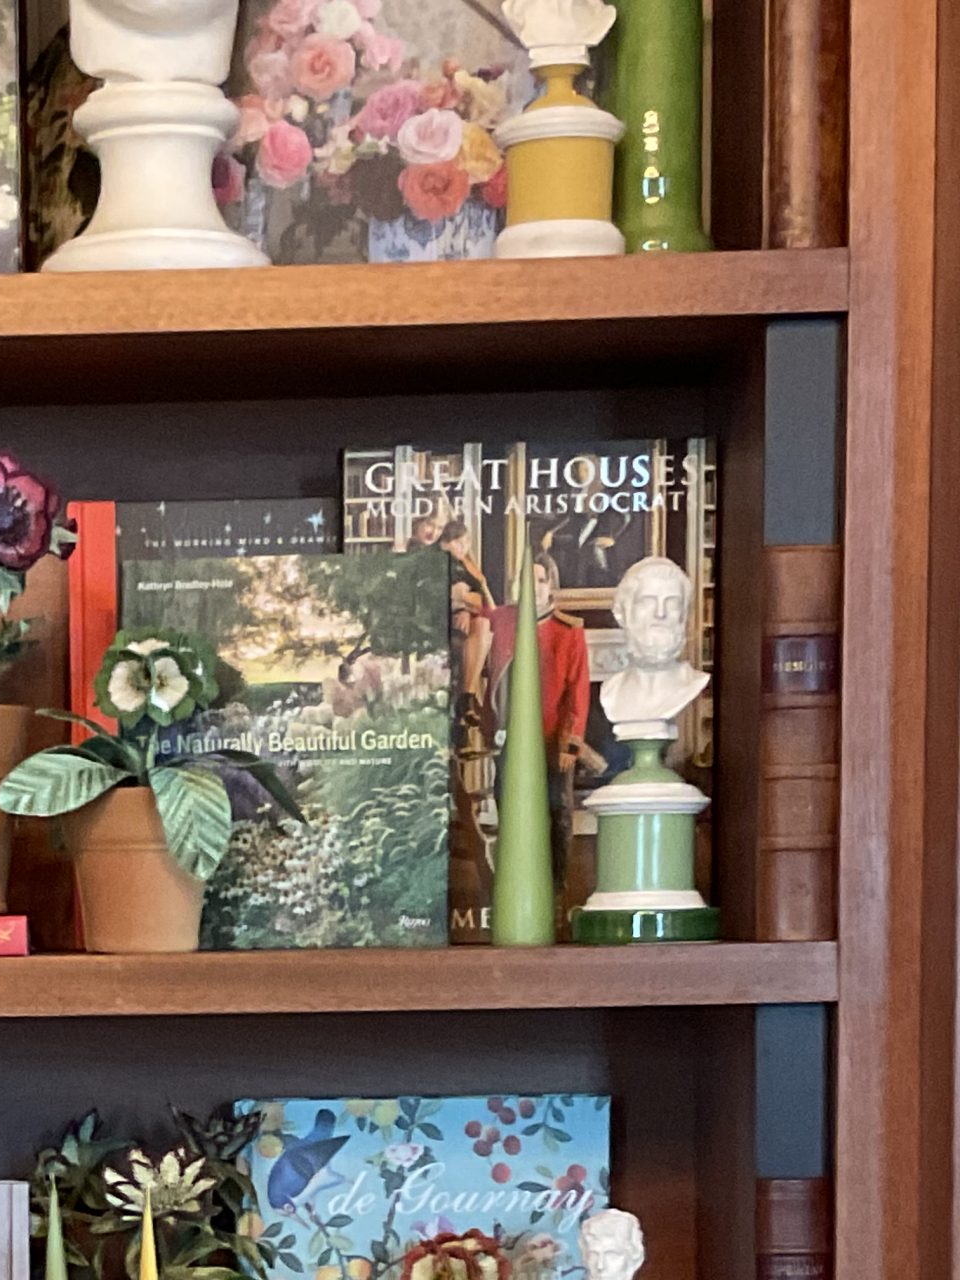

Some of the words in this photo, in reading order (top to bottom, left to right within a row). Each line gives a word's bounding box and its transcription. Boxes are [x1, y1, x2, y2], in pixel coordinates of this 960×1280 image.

[364, 457, 508, 494] GREAT
[529, 454, 698, 490] HOUSES
[173, 537, 231, 548] WORKING
[239, 536, 270, 546] MIND
[268, 730, 356, 753] Beautiful
[360, 727, 434, 750] Garden
[327, 1170, 377, 1216] de
[393, 1161, 594, 1233] Gournay
